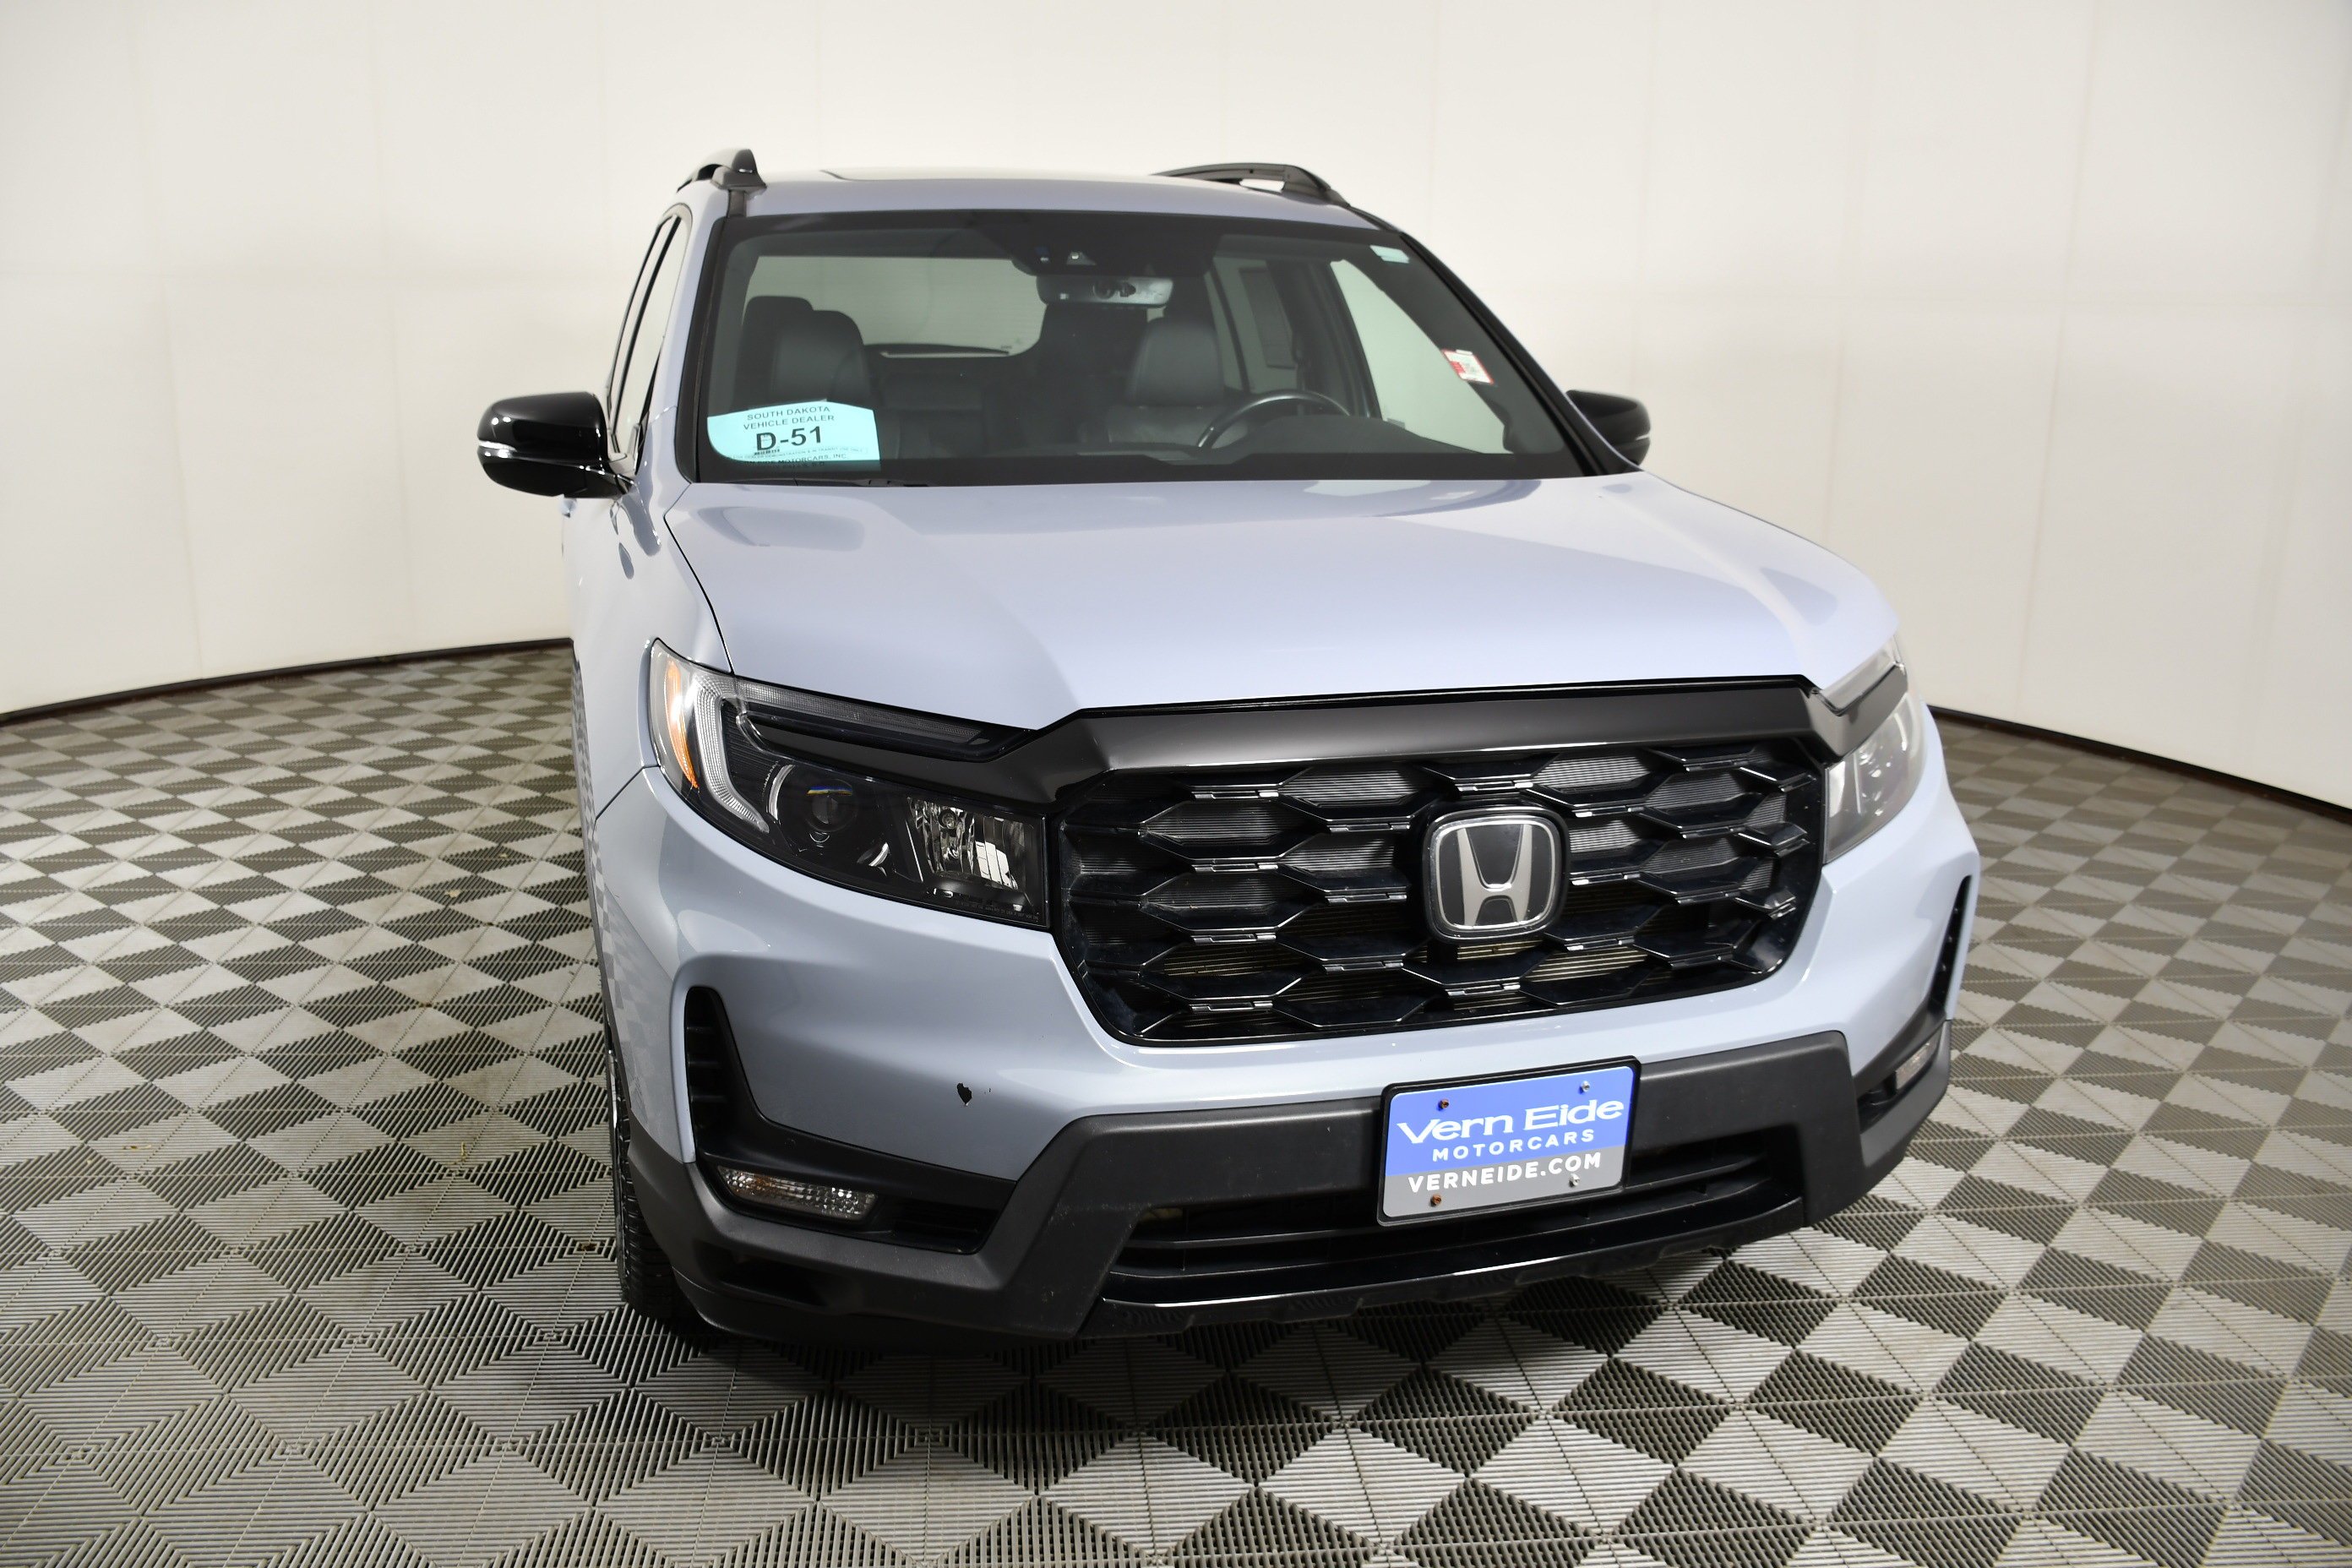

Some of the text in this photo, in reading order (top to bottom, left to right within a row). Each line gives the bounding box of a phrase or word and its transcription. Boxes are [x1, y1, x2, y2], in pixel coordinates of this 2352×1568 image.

[743, 415, 835, 430] VEHICLE DEALER
[747, 406, 830, 421] SOUTH DAKOTA
[756, 426, 821, 450] D-51
[1396, 1099, 1625, 1144] Vern Eide
[1432, 1129, 1594, 1162] MOTORCARS
[1407, 1152, 1602, 1194] VERNEIDE.COM
